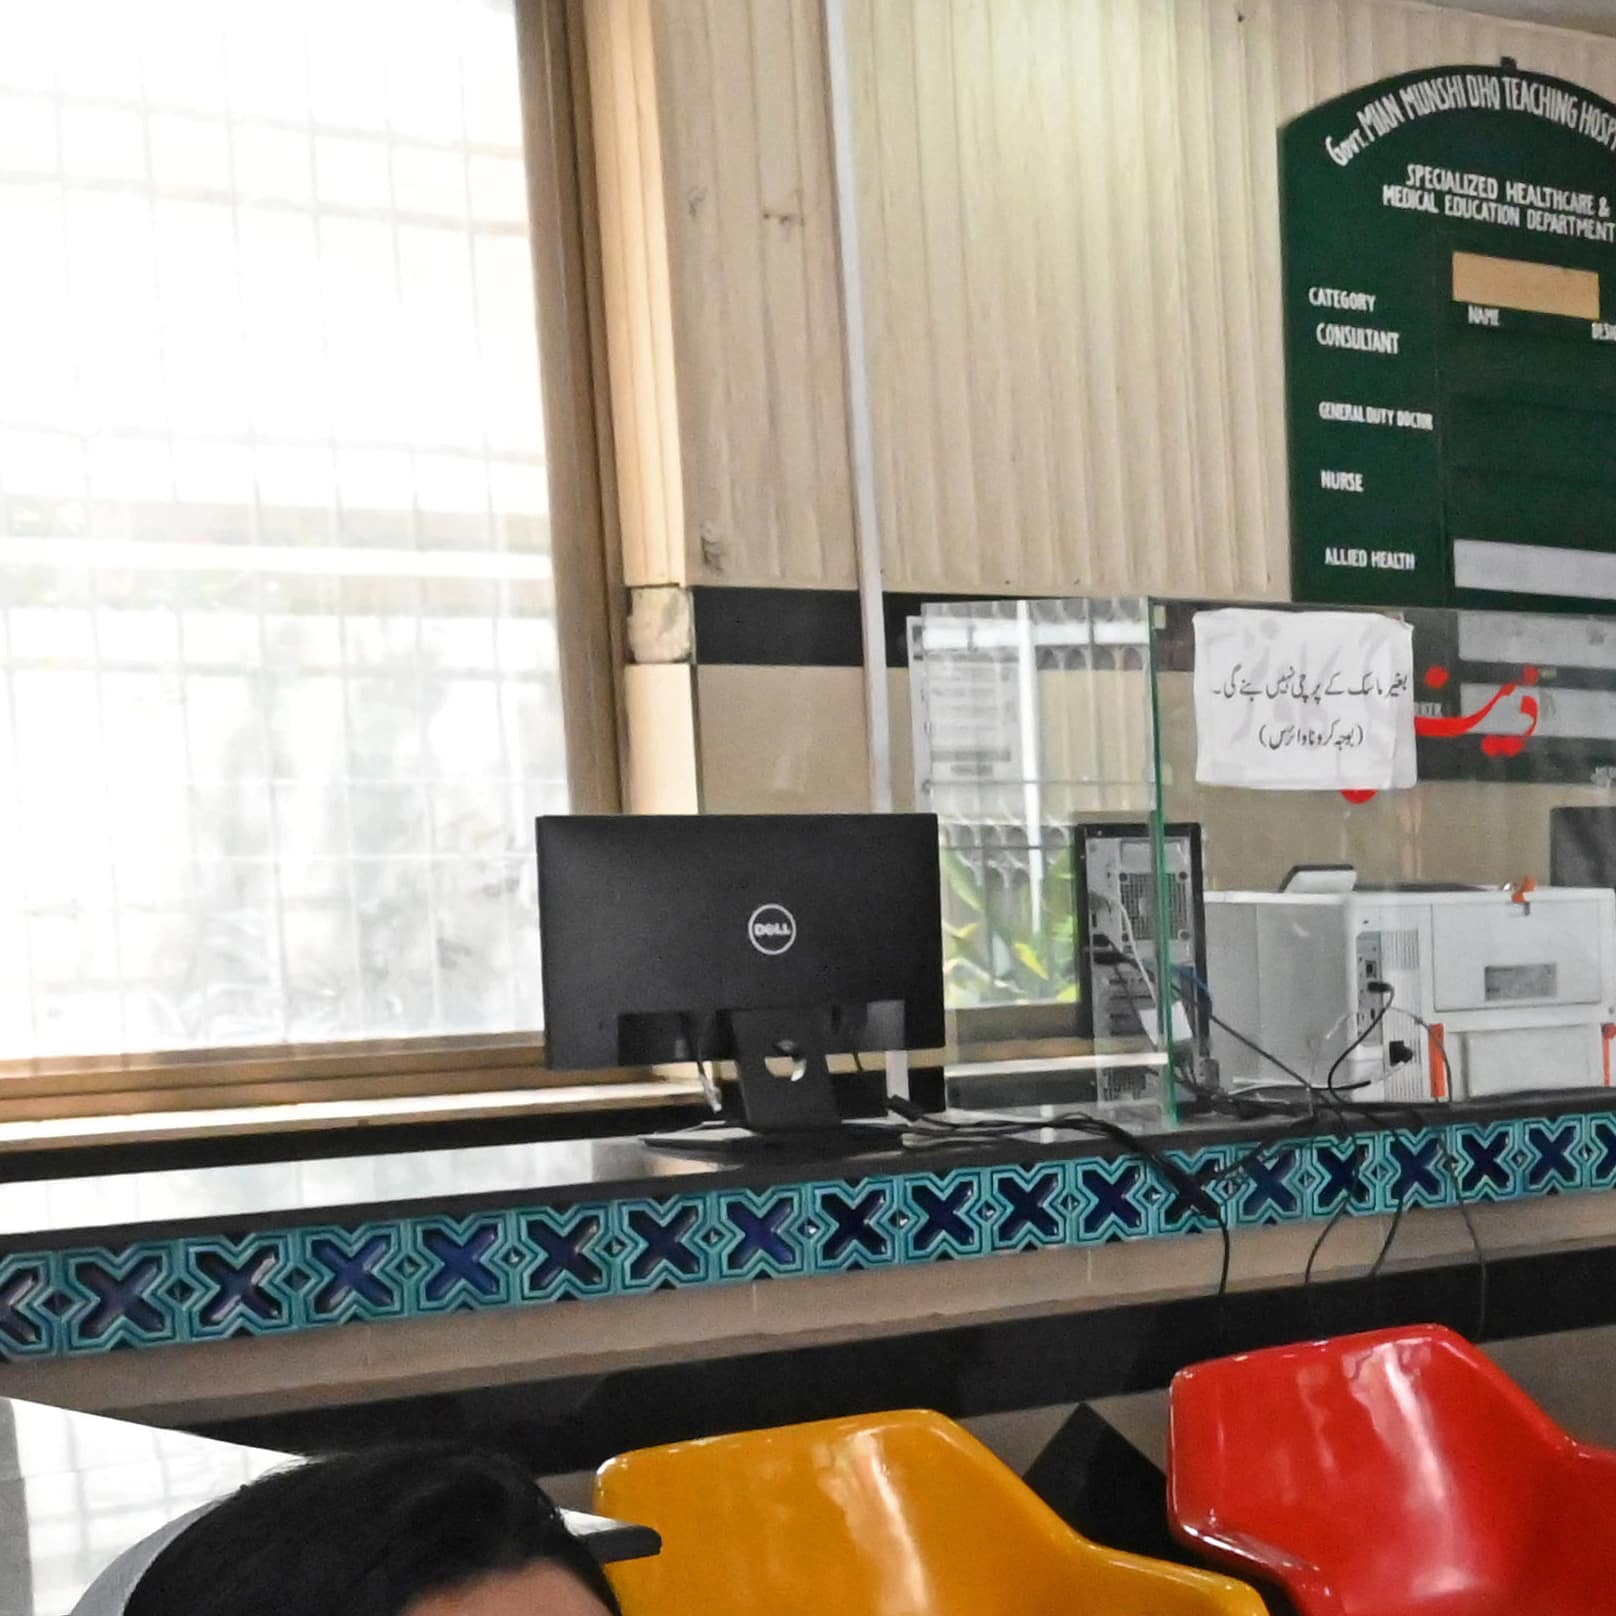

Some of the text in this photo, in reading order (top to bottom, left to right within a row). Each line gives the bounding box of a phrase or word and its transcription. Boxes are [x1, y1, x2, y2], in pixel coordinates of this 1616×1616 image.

[1357, 93, 1405, 142] MIAN
[1399, 75, 1468, 120] MUNSHI
[1502, 77, 1579, 129] TEACHING
[1406, 164, 1611, 218] SPECIALIZED HEALTHCARE &
[1382, 184, 1440, 214] MEDICAL
[1444, 194, 1521, 227] EDUCATION
[1308, 286, 1376, 313] CATEGORY
[1316, 322, 1401, 355] CONSULTANT
[1366, 406, 1395, 426] DUTY
[1320, 469, 1364, 492] NURSE
[1324, 547, 1416, 571] ALLIED HEALTH
[1265, 665, 1296, 699] نہیں
[1324, 671, 1345, 696] کے
[1347, 671, 1384, 696] ماسک
[1384, 672, 1408, 699] بغیر
[753, 921, 792, 938] DELL
